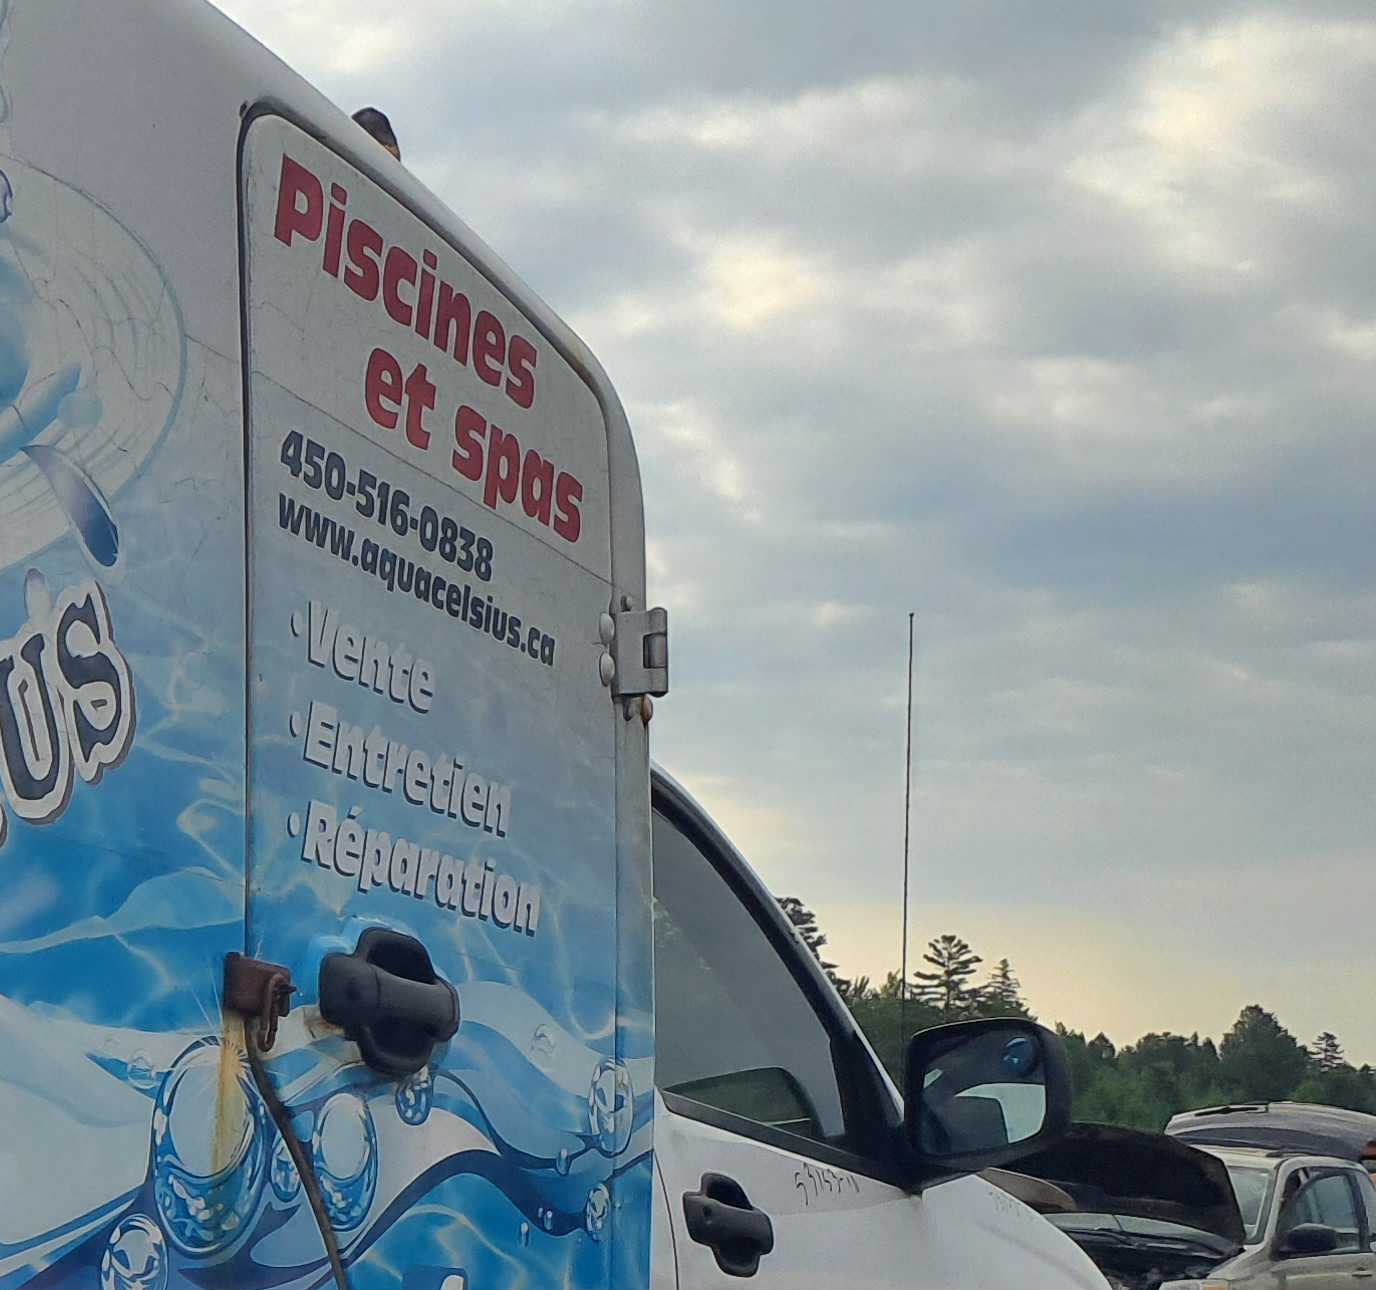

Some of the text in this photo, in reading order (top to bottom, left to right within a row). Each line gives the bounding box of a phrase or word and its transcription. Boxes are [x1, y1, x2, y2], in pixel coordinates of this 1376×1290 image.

[274, 153, 538, 410] Piscines
[280, 430, 494, 582] 450-516-0838
[364, 347, 584, 544] et spas
[278, 493, 556, 667] www.aquacelsius.ca
